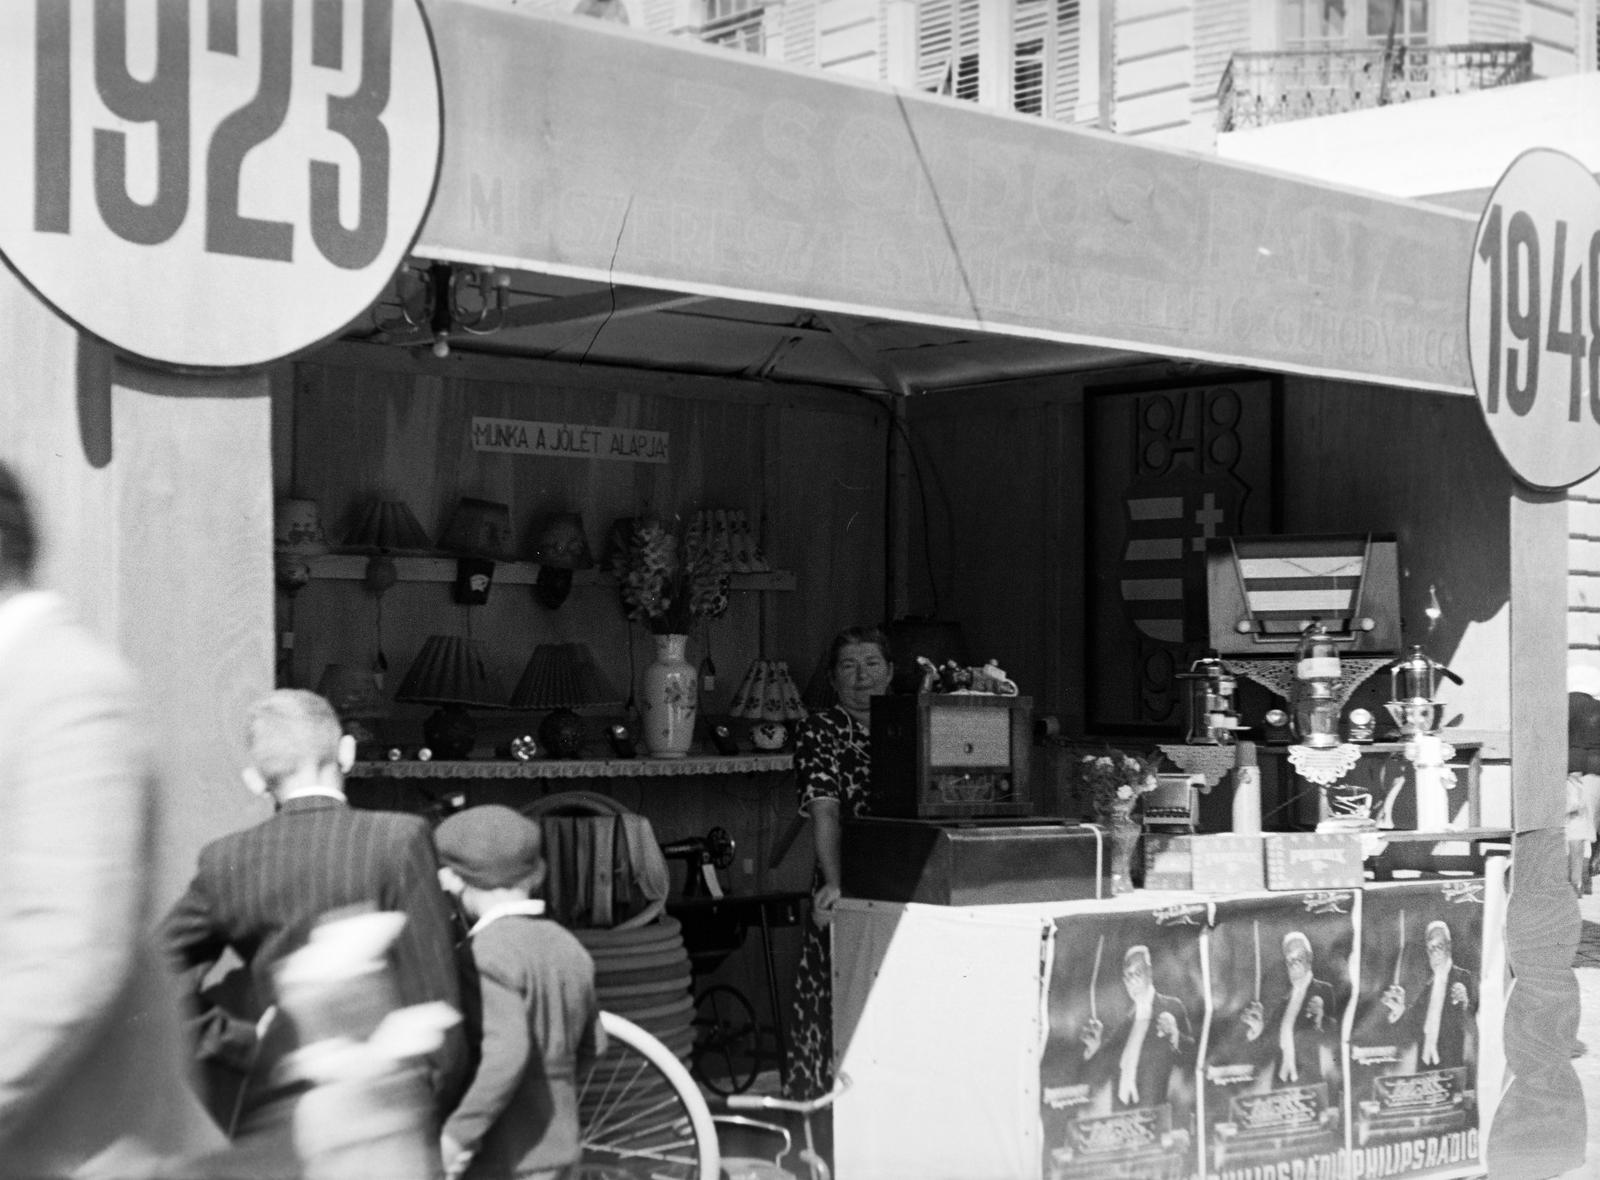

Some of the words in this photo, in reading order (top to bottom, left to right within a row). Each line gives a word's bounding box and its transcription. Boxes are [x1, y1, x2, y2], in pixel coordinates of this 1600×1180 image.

[34, 0, 394, 271] 1923
[535, 427, 547, 450] A
[1134, 387, 1242, 476] 1848
